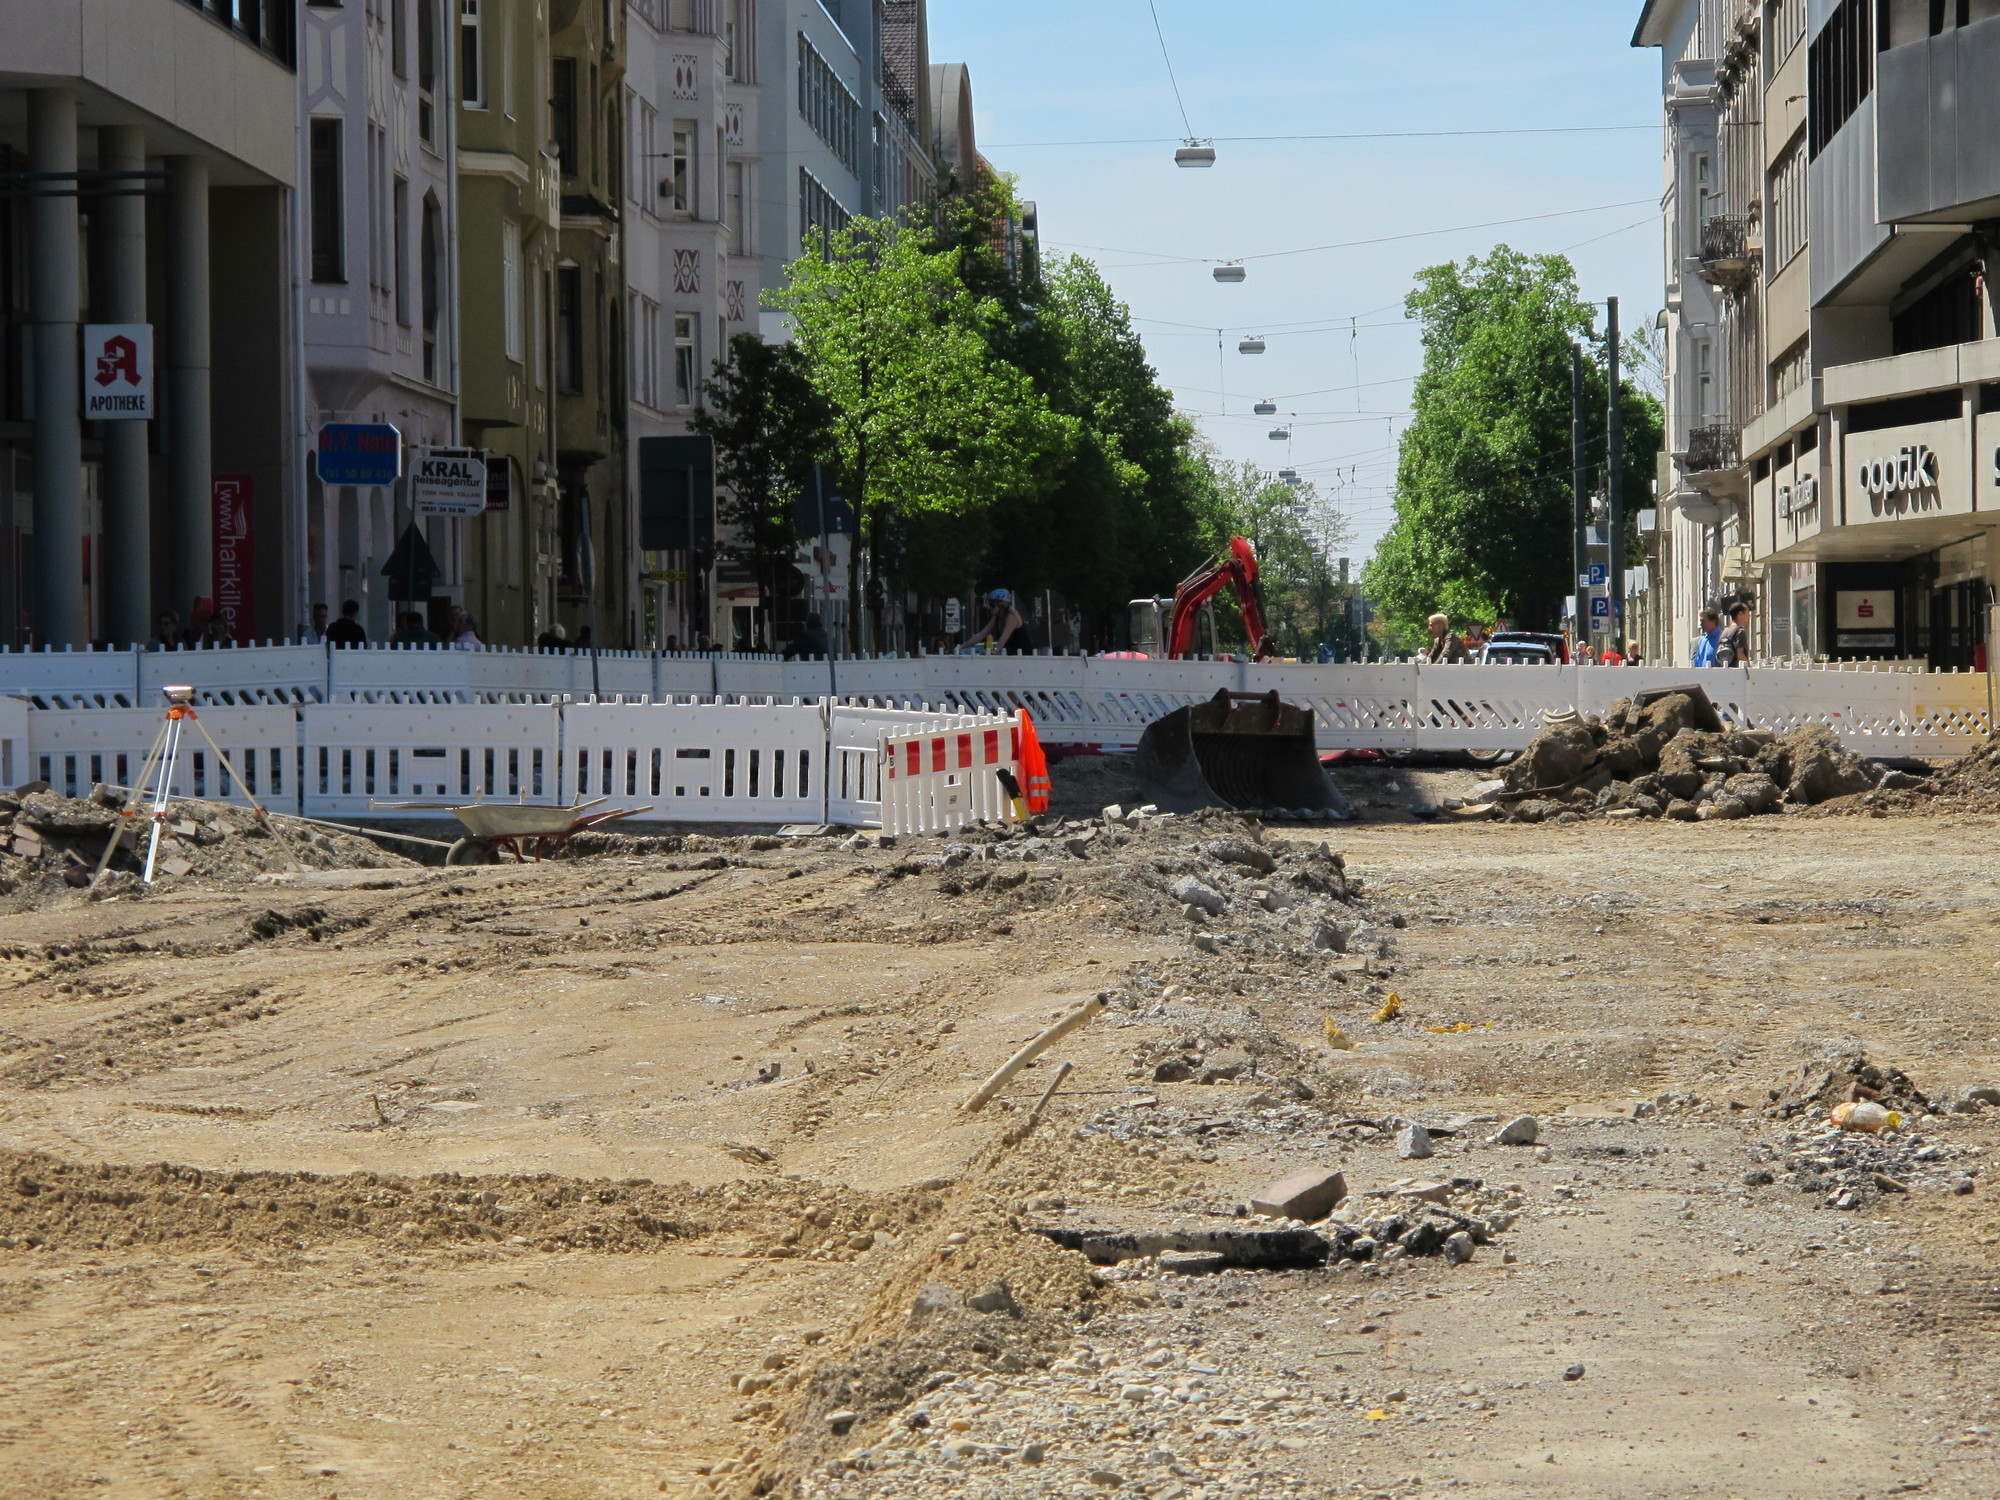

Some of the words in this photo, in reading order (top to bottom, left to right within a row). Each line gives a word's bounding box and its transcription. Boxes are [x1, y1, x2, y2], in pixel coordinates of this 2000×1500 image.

[90, 395, 146, 411] APOTHEKE
[421, 461, 472, 478] KRAL
[412, 475, 480, 487] Reiseagentur
[1591, 566, 1600, 582] P
[1596, 600, 1605, 614] P
